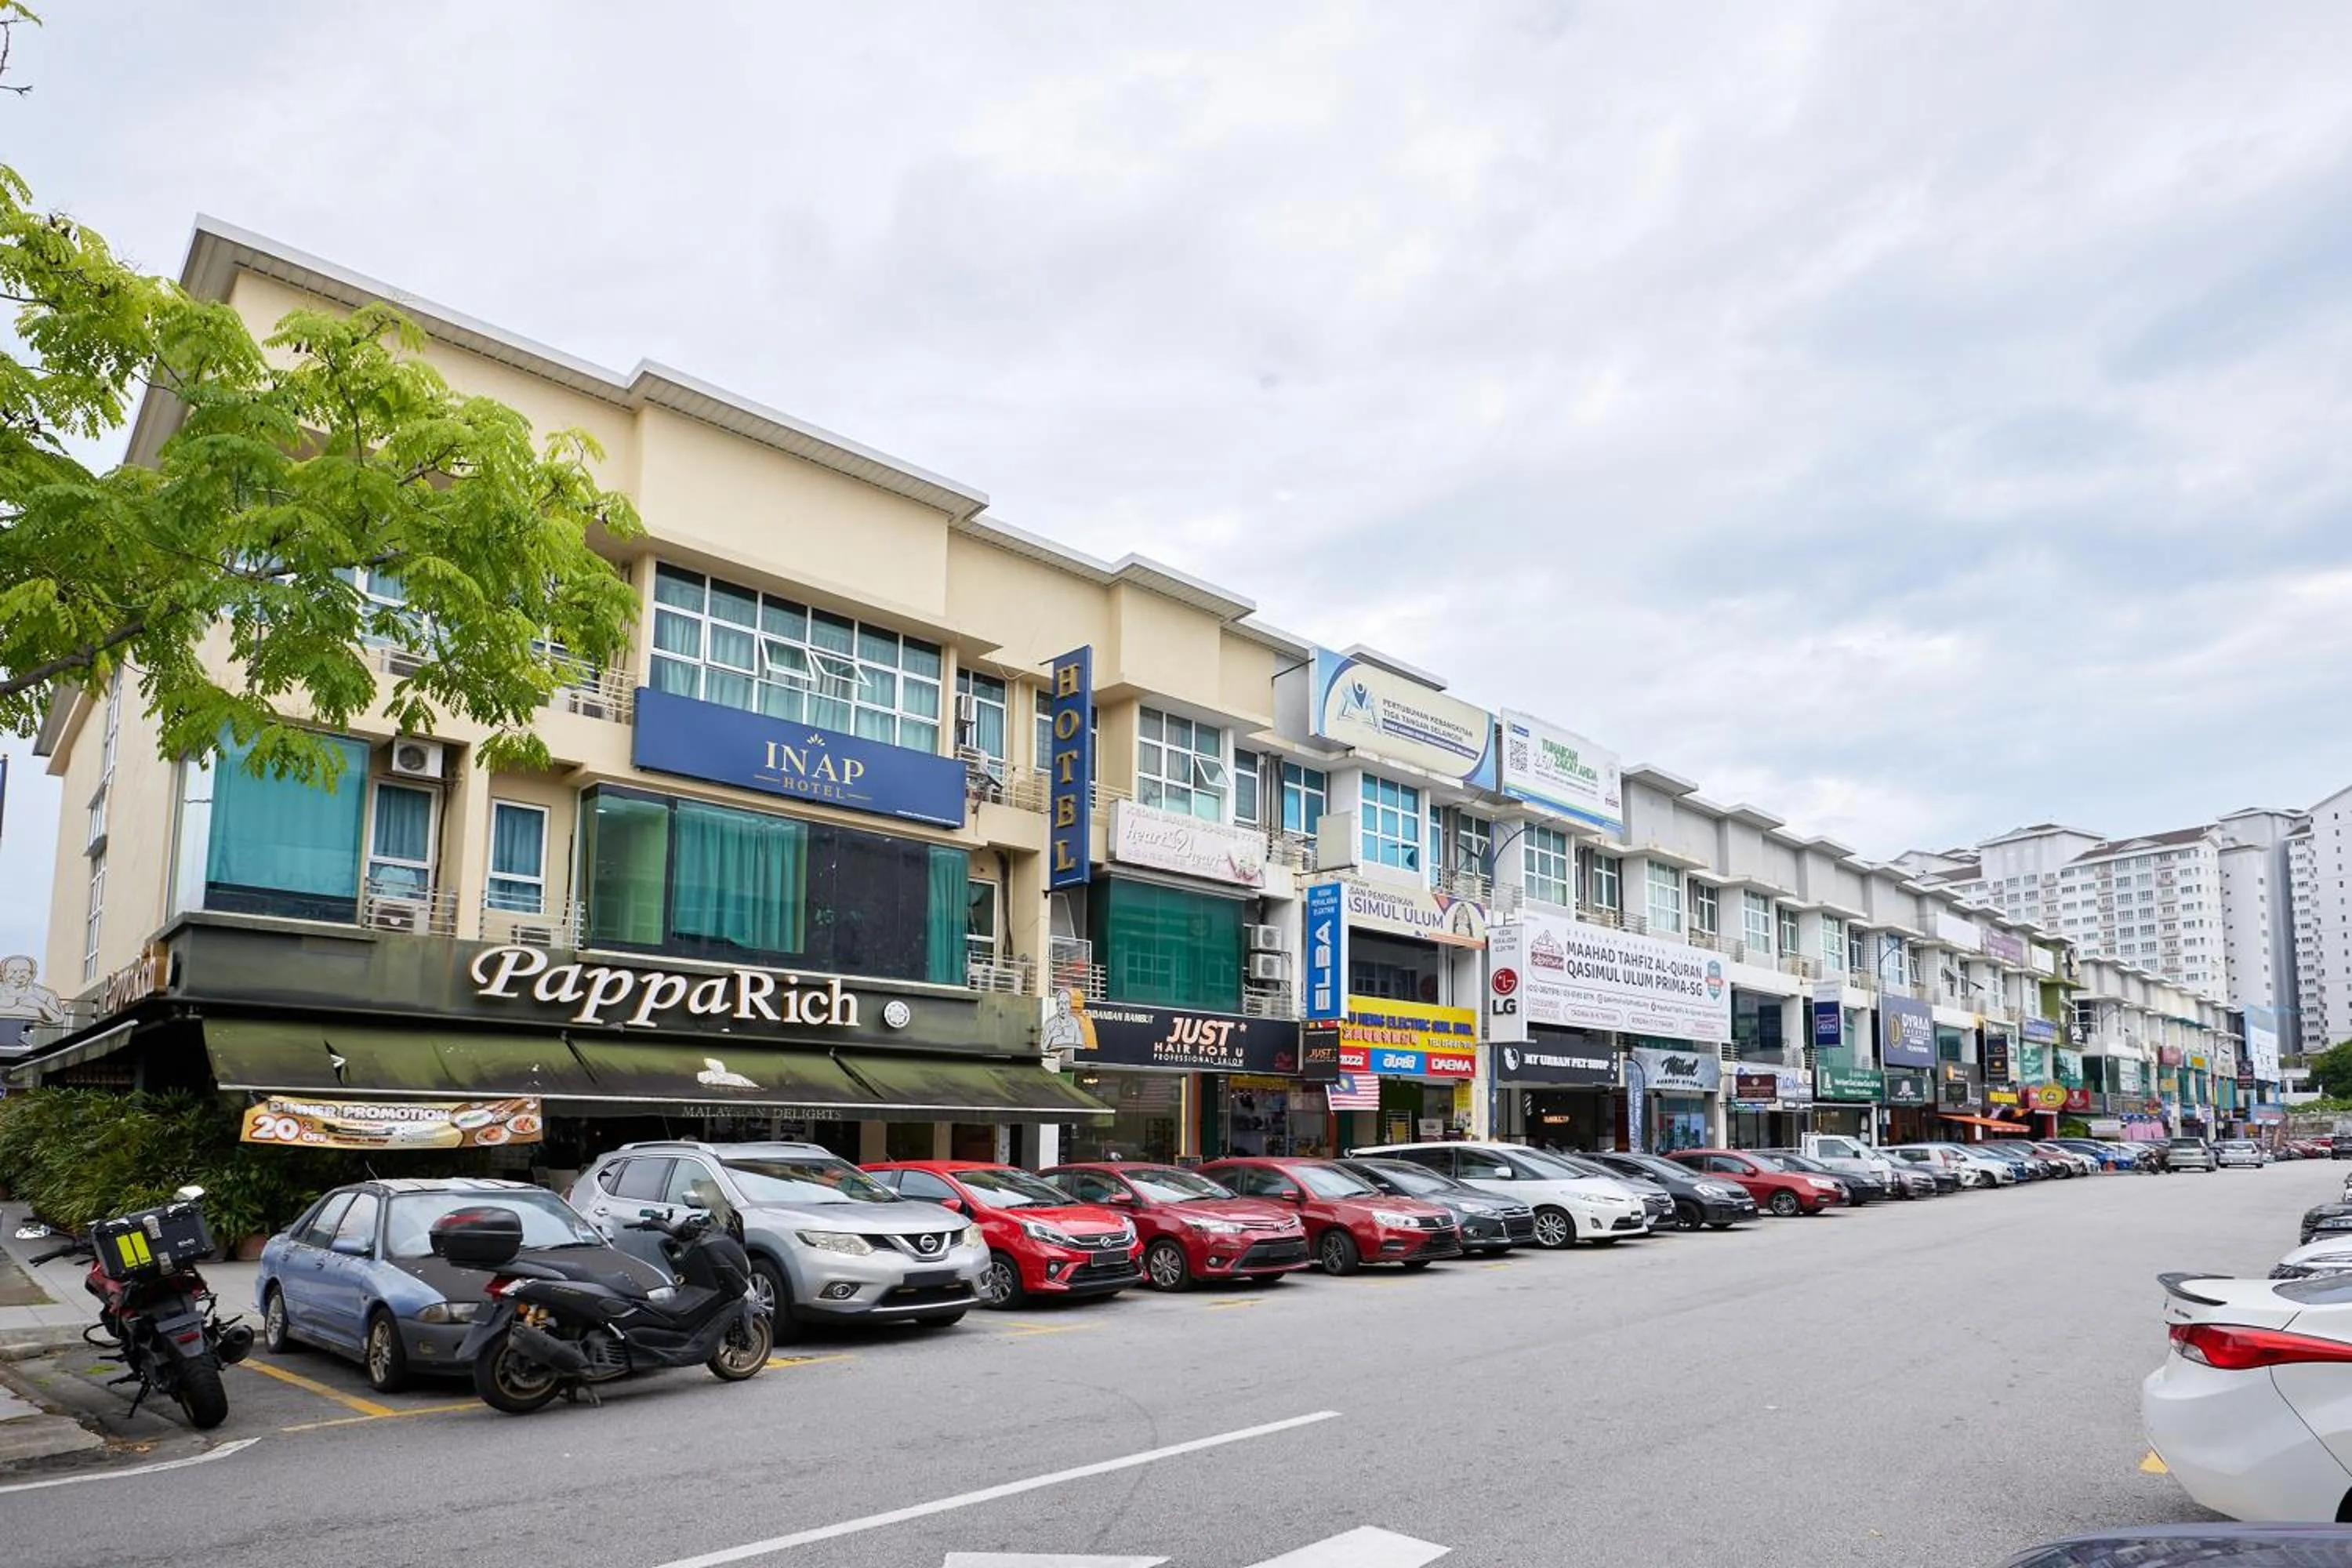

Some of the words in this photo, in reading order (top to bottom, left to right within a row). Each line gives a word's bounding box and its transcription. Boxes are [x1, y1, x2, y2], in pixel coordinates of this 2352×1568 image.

[765, 740, 866, 786] INAP
[1054, 662, 1080, 872] HOTEL
[782, 777, 845, 800] HOTEL
[1404, 907, 1443, 929] ULUM
[1315, 919, 1332, 1011] ELBA
[1567, 940, 1616, 964] MAAHAD
[1617, 951, 1653, 971] TAHFIZ
[1655, 958, 1703, 979] AL-QURAN
[471, 945, 861, 1028] PappaRich
[1567, 959, 1621, 983] QASIMUL
[1622, 969, 1653, 988] ULUM
[1655, 975, 1703, 996] PRIMA-SG
[1492, 998, 1517, 1016] LG
[1166, 1017, 1236, 1047] JUST
[1153, 1042, 1191, 1054] HAIR
[1199, 1045, 1228, 1057] FOR
[1235, 1047, 1243, 1058] U
[1153, 1053, 1214, 1064] PROFESSIONAL
[268, 1101, 338, 1118] DINNER
[343, 1105, 451, 1122] PROMOTION
[773, 1108, 842, 1120] DELIGHTS
[250, 1114, 302, 1142] 20
[302, 1133, 327, 1143] OFF
